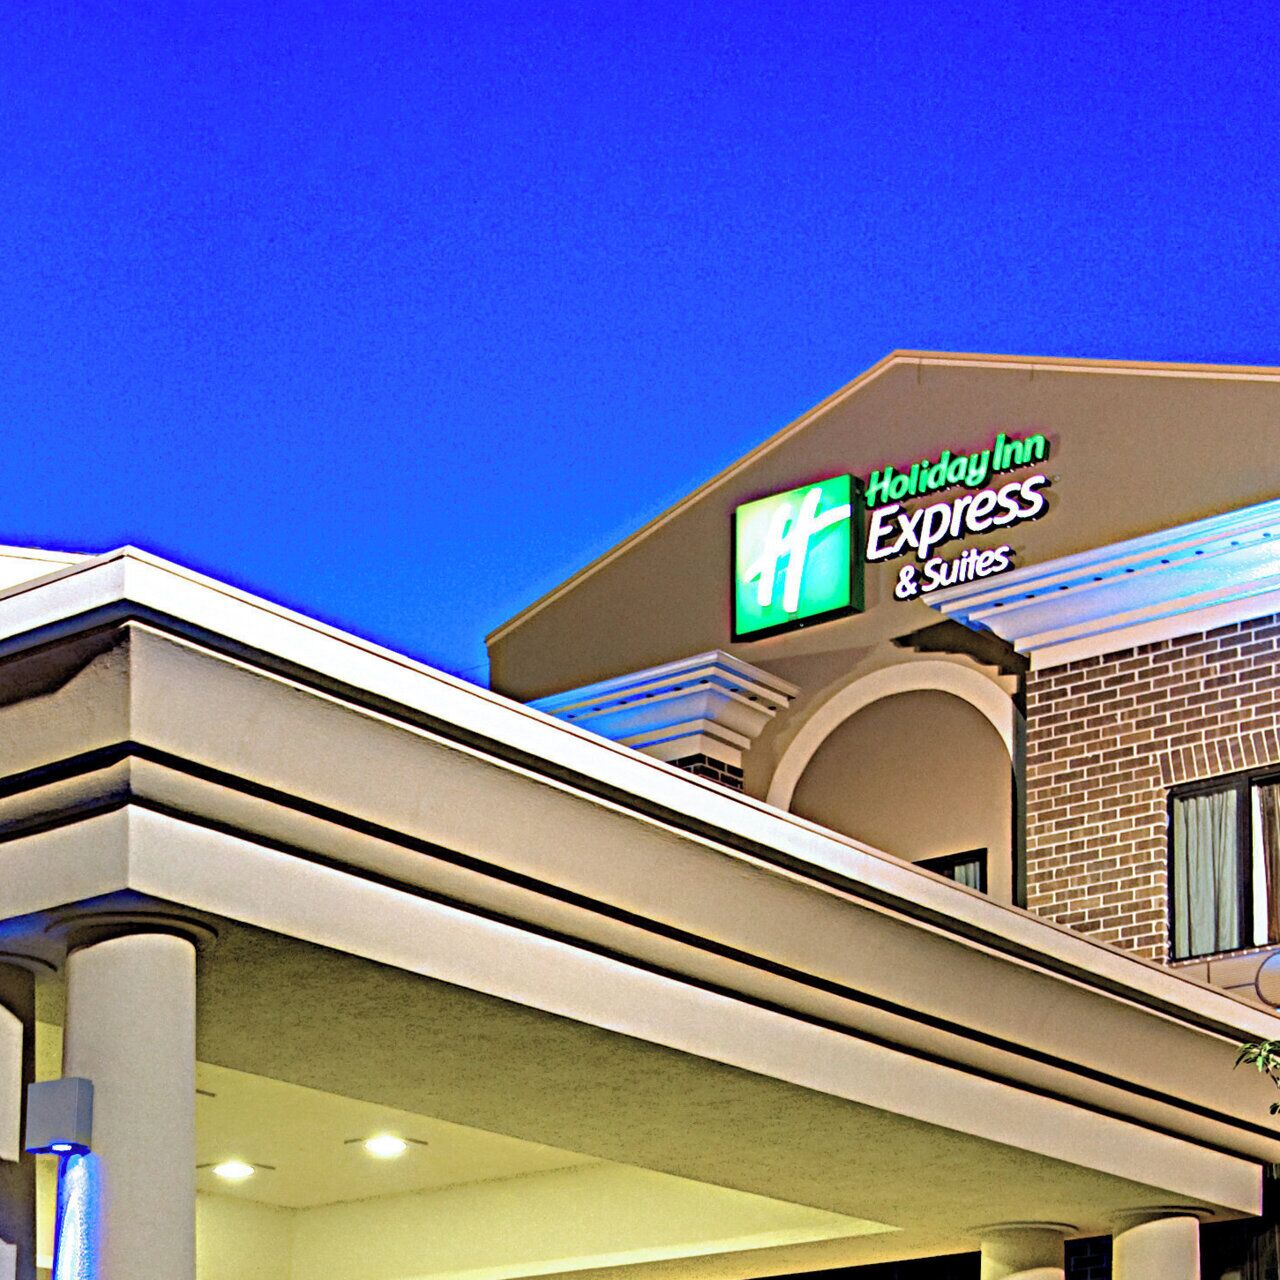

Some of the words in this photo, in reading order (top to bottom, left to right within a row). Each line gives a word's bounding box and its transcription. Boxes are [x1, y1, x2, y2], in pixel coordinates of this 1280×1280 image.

[865, 450, 990, 506] Holiday
[993, 433, 1046, 470] Inn
[866, 475, 1047, 561] Express
[895, 565, 918, 599] &
[921, 545, 1011, 592] Suites
